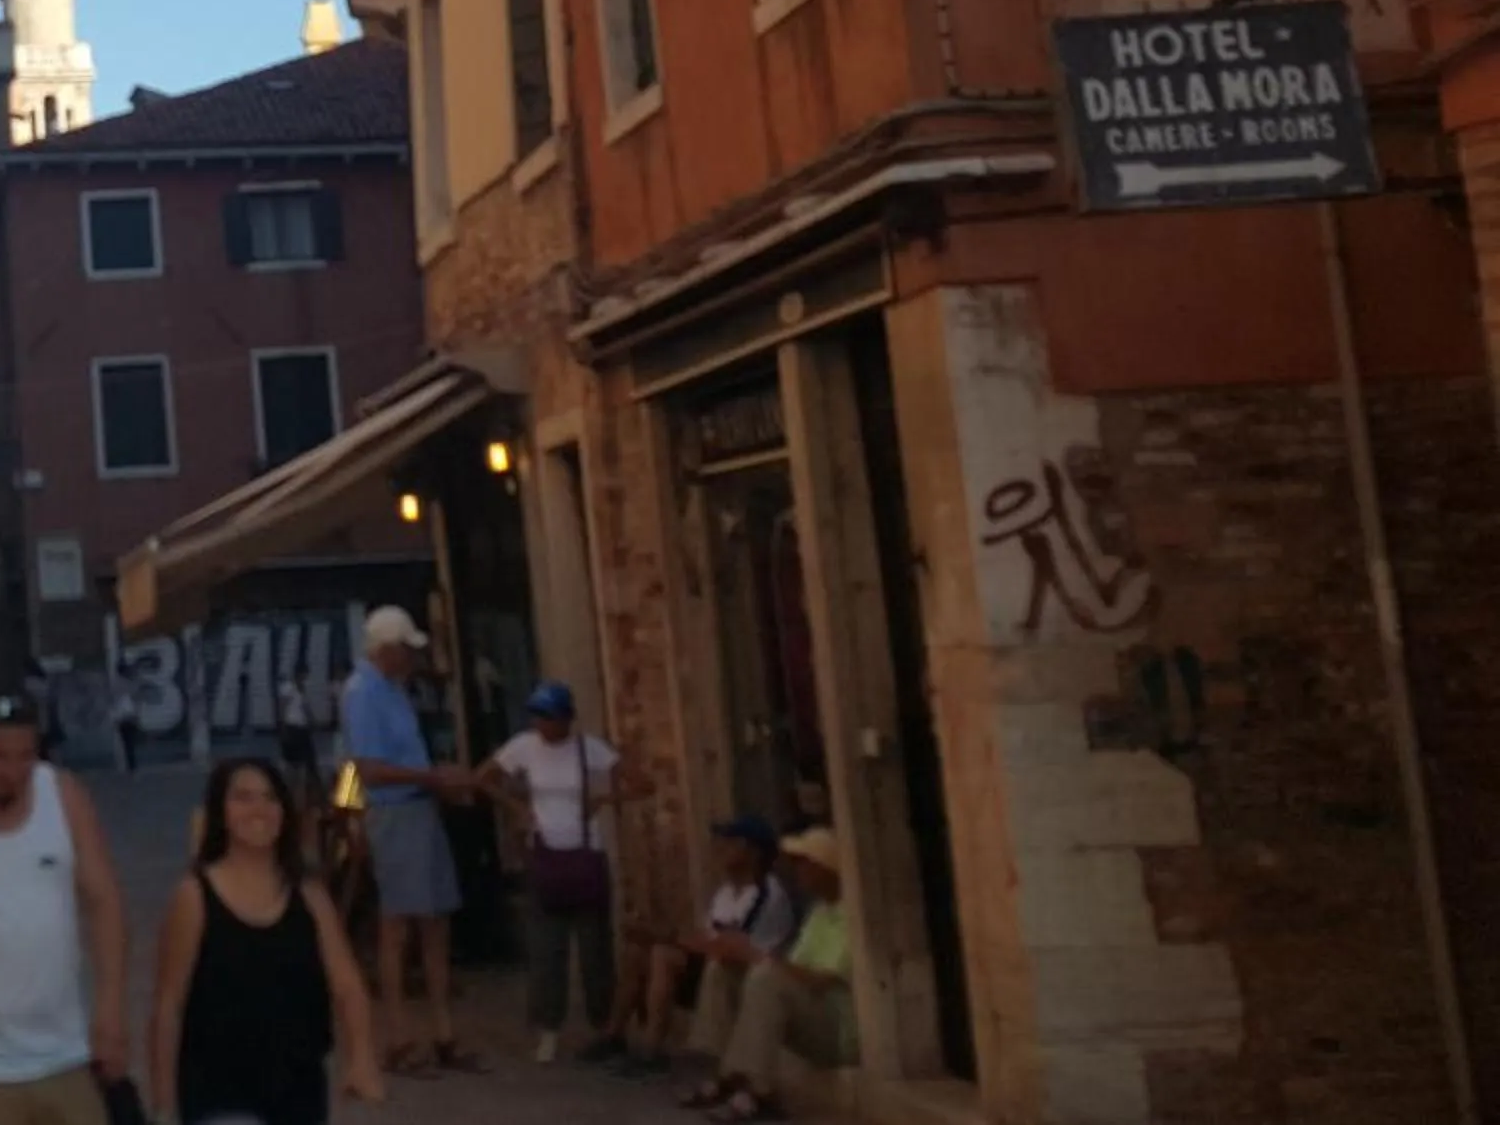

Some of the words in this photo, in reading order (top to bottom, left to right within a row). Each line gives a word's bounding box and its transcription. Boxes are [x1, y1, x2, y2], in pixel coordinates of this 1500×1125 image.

[1111, 20, 1265, 69] HOTEL
[1082, 73, 1215, 122] DALLA
[1219, 62, 1342, 112] MORA
[1105, 121, 1217, 156] CAMERE
[1240, 113, 1337, 147] ROOMS
